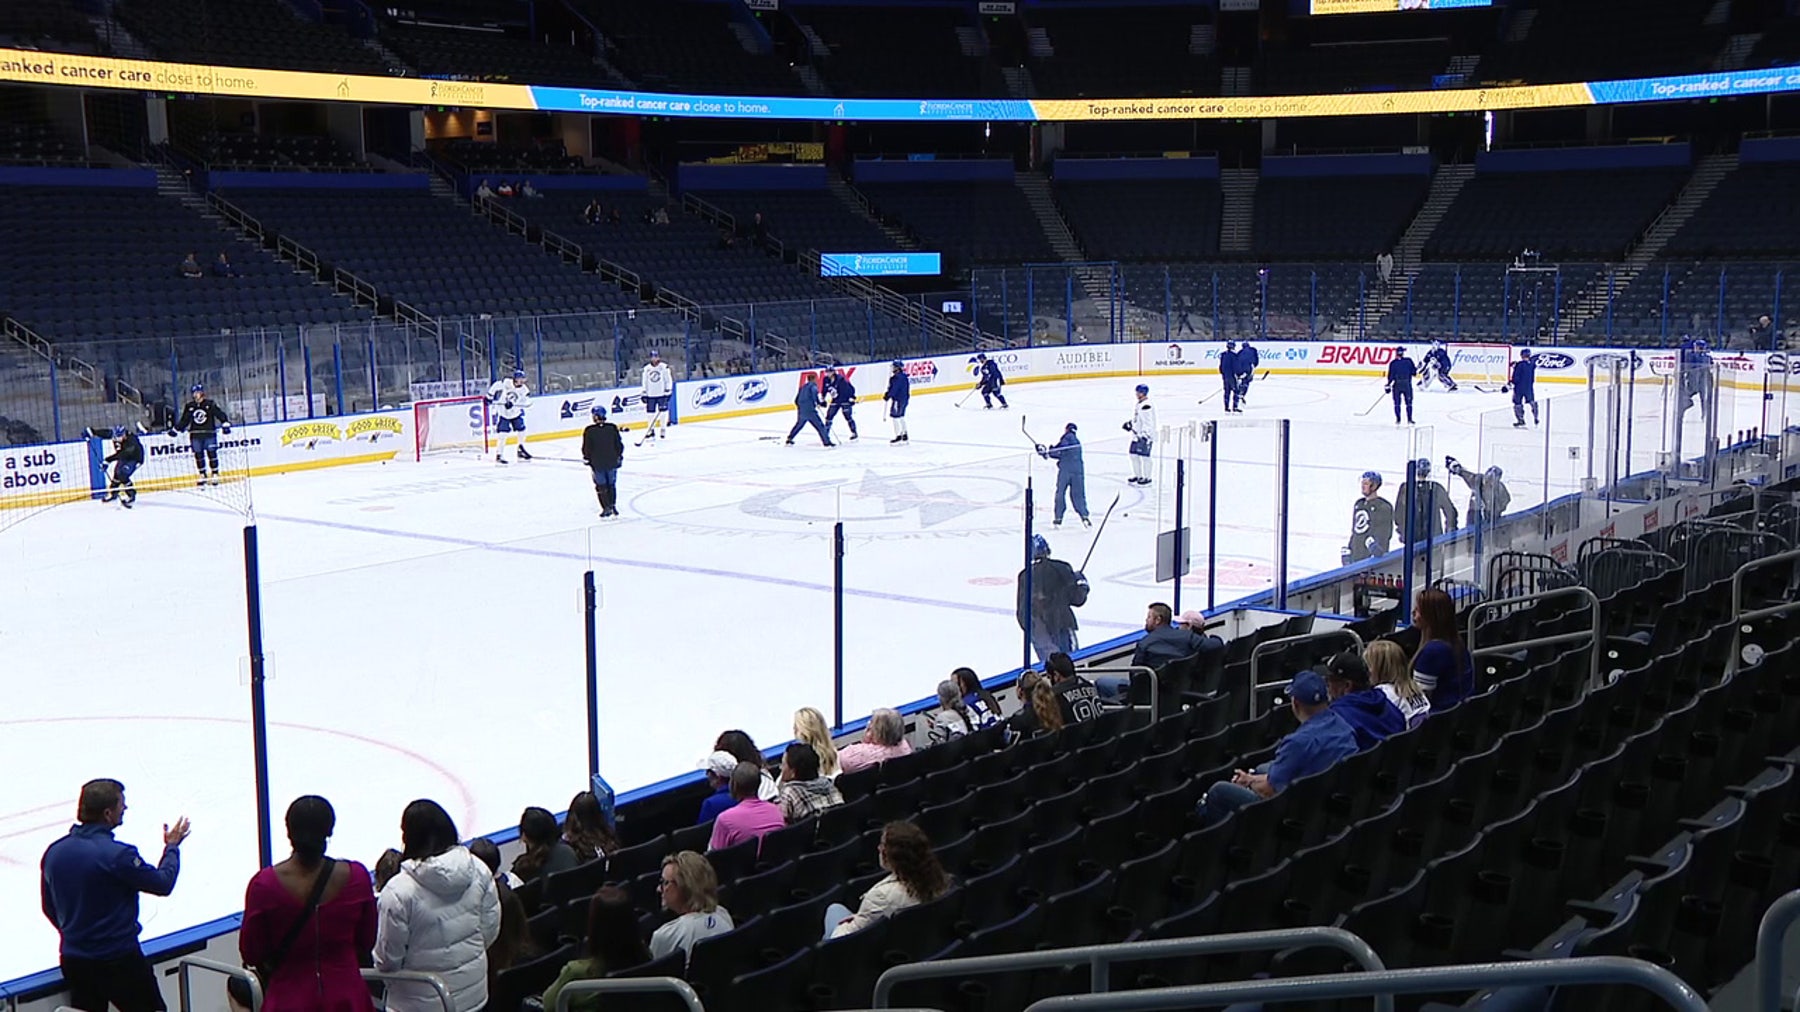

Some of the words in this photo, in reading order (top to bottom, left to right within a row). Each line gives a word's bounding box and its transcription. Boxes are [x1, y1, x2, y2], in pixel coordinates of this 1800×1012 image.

[61, 64, 114, 80] cancer
[119, 68, 151, 82] care
[157, 73, 193, 85] close
[197, 75, 212, 86] to
[216, 76, 258, 89] home.
[1651, 77, 1731, 95] Top-ranked
[1733, 75, 1784, 88] cancer
[579, 94, 634, 110] Top-ranked
[637, 100, 667, 110] cancer
[669, 102, 690, 111] care
[693, 101, 721, 112] close
[724, 103, 735, 112] to
[738, 102, 771, 113] home.
[1088, 104, 1153, 117] Top-ranked
[1157, 105, 1195, 114] cancer
[1199, 104, 1224, 113] care
[1227, 103, 1256, 113] close
[1260, 103, 1272, 112] to
[1275, 101, 1312, 112] home.
[1057, 352, 1112, 364] AUDIBEL
[1316, 346, 1397, 365] BRAND
[1535, 353, 1567, 368] Ford
[150, 438, 261, 456] Micrumen
[5, 456, 16, 469] a
[23, 450, 56, 468] sub
[3, 471, 61, 488] above
